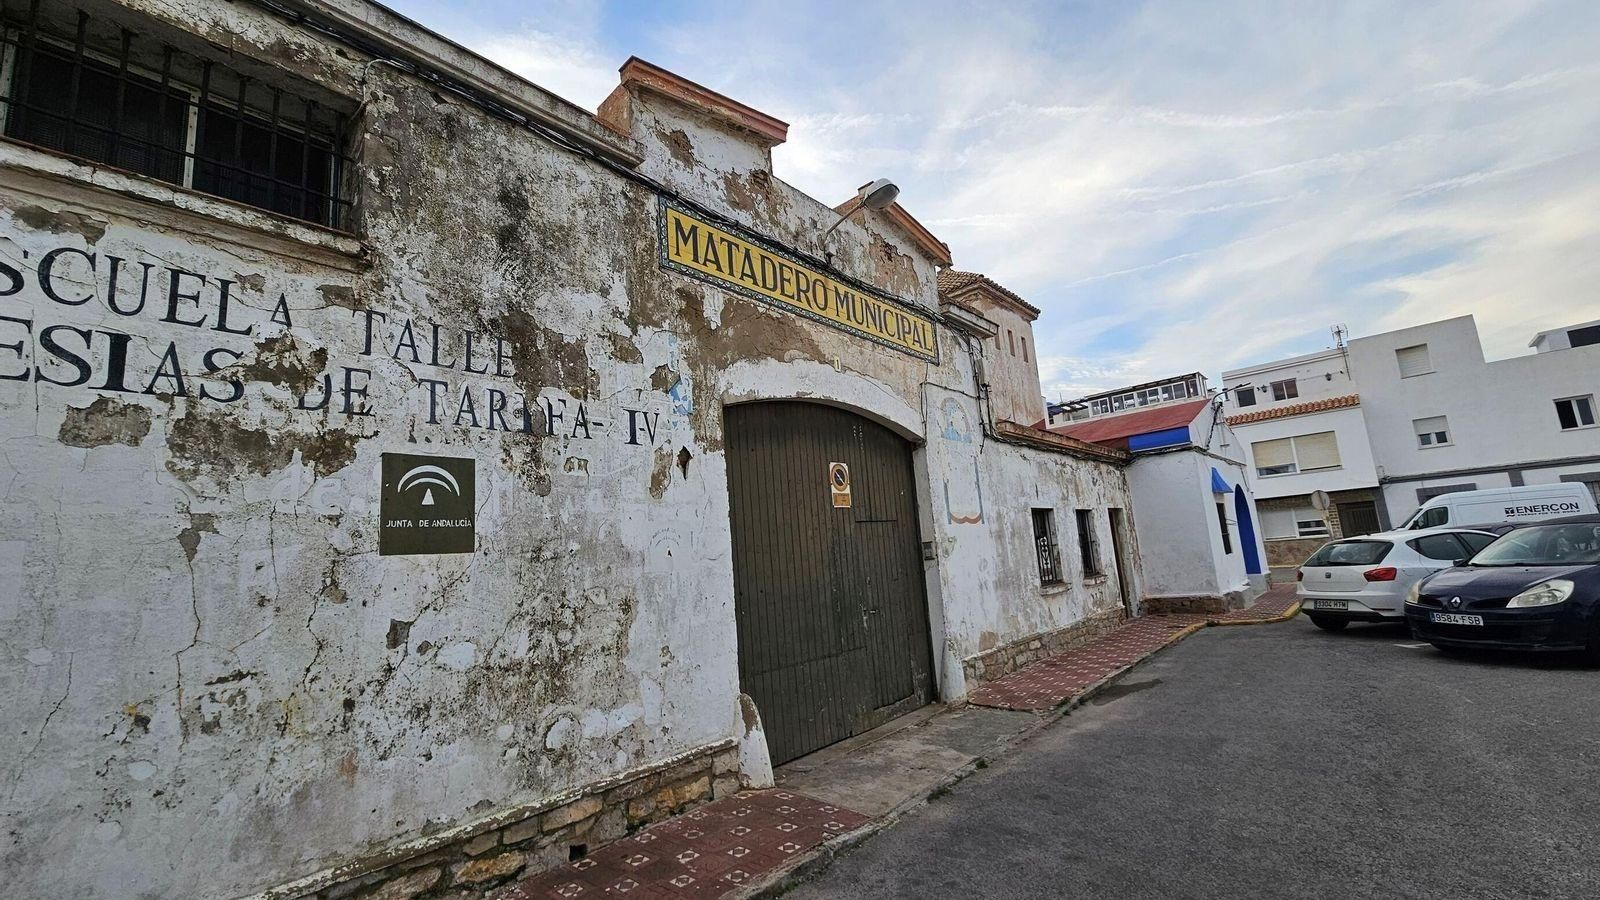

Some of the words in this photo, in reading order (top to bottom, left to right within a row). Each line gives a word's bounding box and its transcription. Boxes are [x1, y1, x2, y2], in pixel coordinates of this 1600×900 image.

[673, 216, 828, 312] MATADERO
[834, 285, 933, 352] MUNICIPAL
[1515, 502, 1580, 514] ENERCON
[386, 519, 413, 528] JUNTA
[418, 519, 430, 528] DE
[1460, 615, 1481, 625] FSB
